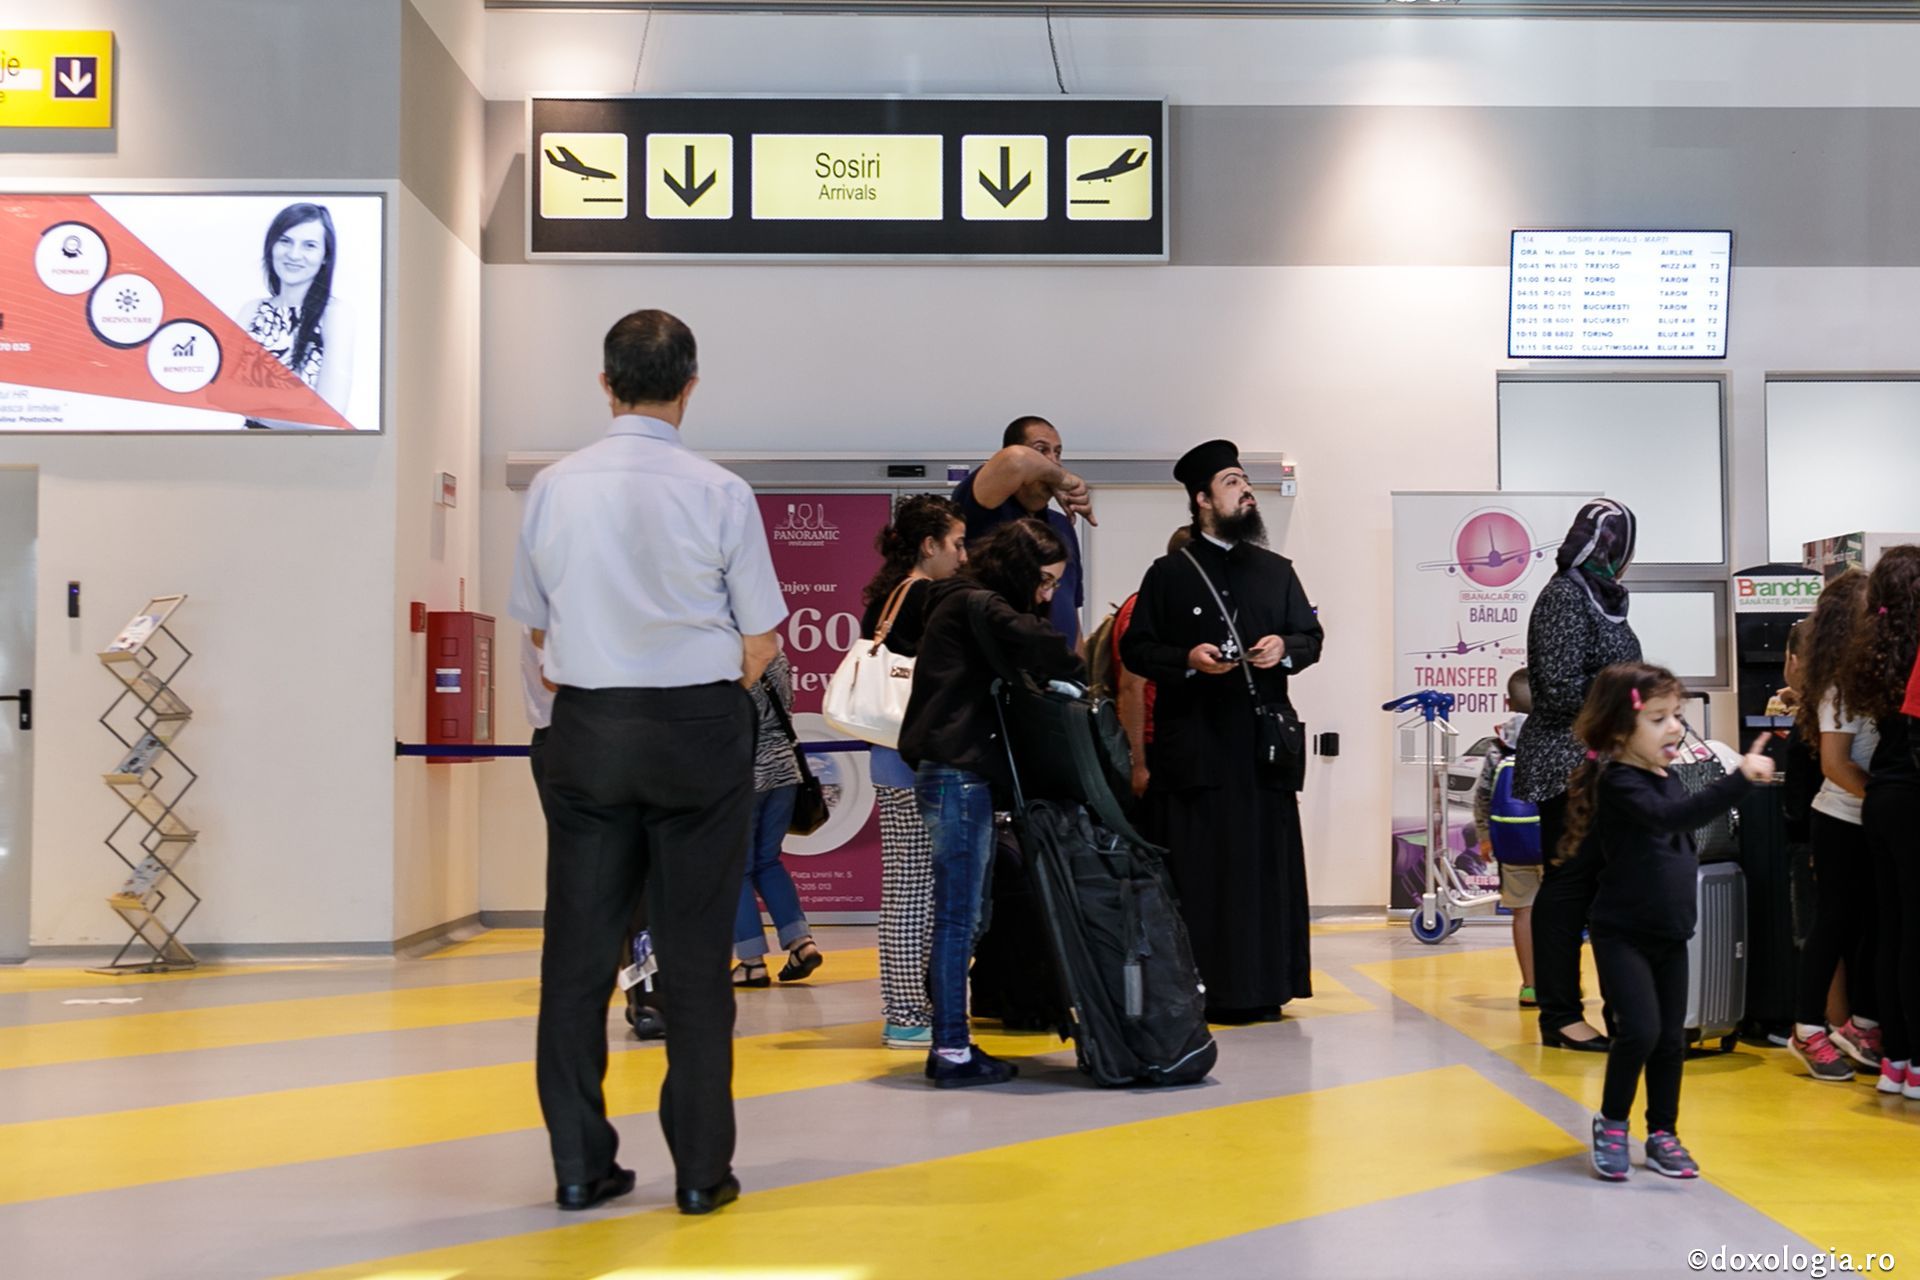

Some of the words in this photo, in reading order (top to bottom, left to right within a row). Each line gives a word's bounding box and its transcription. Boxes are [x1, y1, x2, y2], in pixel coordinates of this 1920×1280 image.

[815, 152, 880, 178] Sosiri
[818, 184, 877, 200] Arrivals
[773, 530, 840, 541] PANORAMIC
[813, 584, 838, 593] our
[1737, 577, 1821, 597] Branché
[1462, 592, 1527, 601] IBANACAR.RO
[1469, 604, 1518, 623] BÂRLAD
[1414, 667, 1497, 687] TRANSFER
